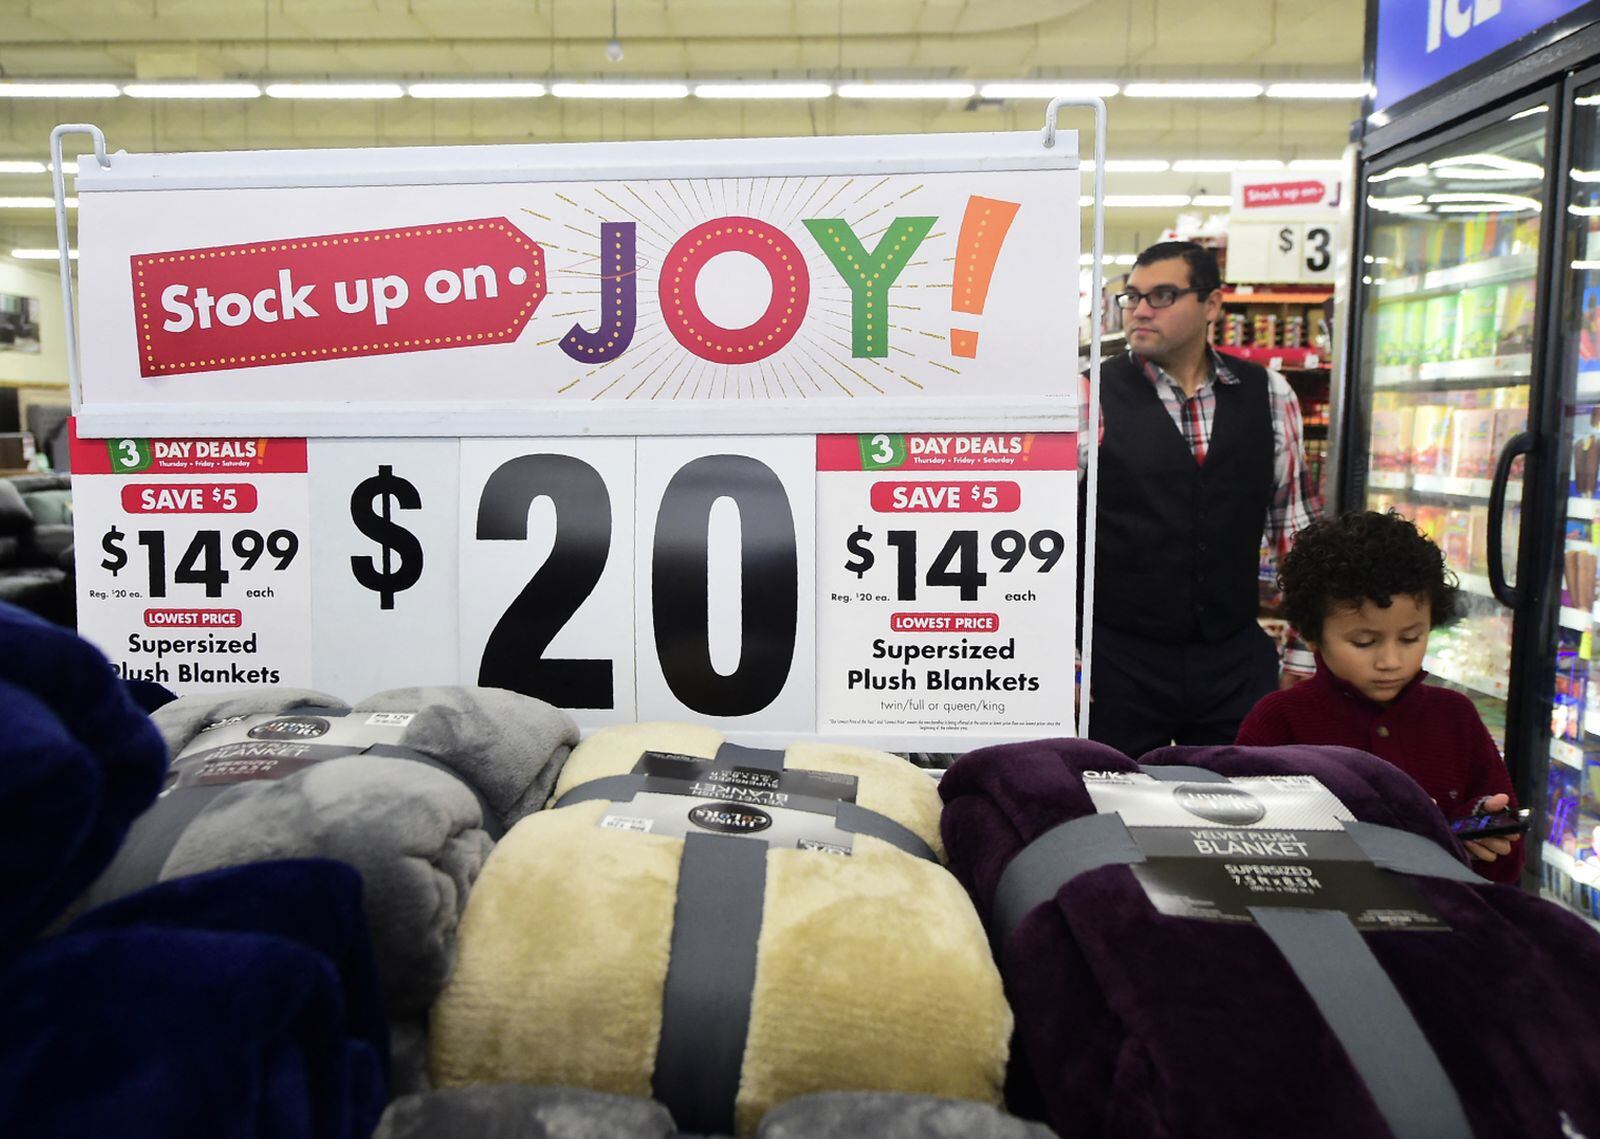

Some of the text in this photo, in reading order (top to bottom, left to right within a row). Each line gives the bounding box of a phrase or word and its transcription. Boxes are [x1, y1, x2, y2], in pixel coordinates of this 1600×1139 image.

[1248, 189, 1279, 201] Stock
[558, 195, 1021, 365] JOY!
[161, 264, 498, 333] Stock up on
[118, 439, 141, 468] 3
[155, 442, 194, 458] DAY
[871, 434, 894, 464] 3
[910, 437, 952, 455] DAY
[159, 460, 187, 468] Thursday
[195, 460, 215, 468] Friday
[914, 457, 1015, 465] Thursday Friday Saturday
[141, 487, 238, 510] SAVE $5
[892, 485, 998, 509] SAVE $5
[89, 590, 109, 599] Reg.
[111, 589, 127, 598] $20
[246, 588, 274, 598] each
[831, 593, 852, 603] Reg.
[855, 592, 872, 602] $20
[1005, 590, 1036, 602] each
[148, 613, 237, 624] LOWEST PRICE
[896, 617, 993, 629] LOWEST PRICE
[128, 633, 257, 658] Supersized
[872, 638, 1015, 665] Supersized
[178, 663, 280, 683] Blankets
[848, 669, 1040, 692] Plush Blankets
[881, 700, 1005, 714] twin/full or queen/king
[689, 782, 789, 802] BLANKET
[736, 794, 784, 806] VELVET
[1191, 831, 1297, 842] VELVET PLUSH
[1194, 840, 1307, 857] BLANKET
[1224, 864, 1312, 878] SUPERSIZED
